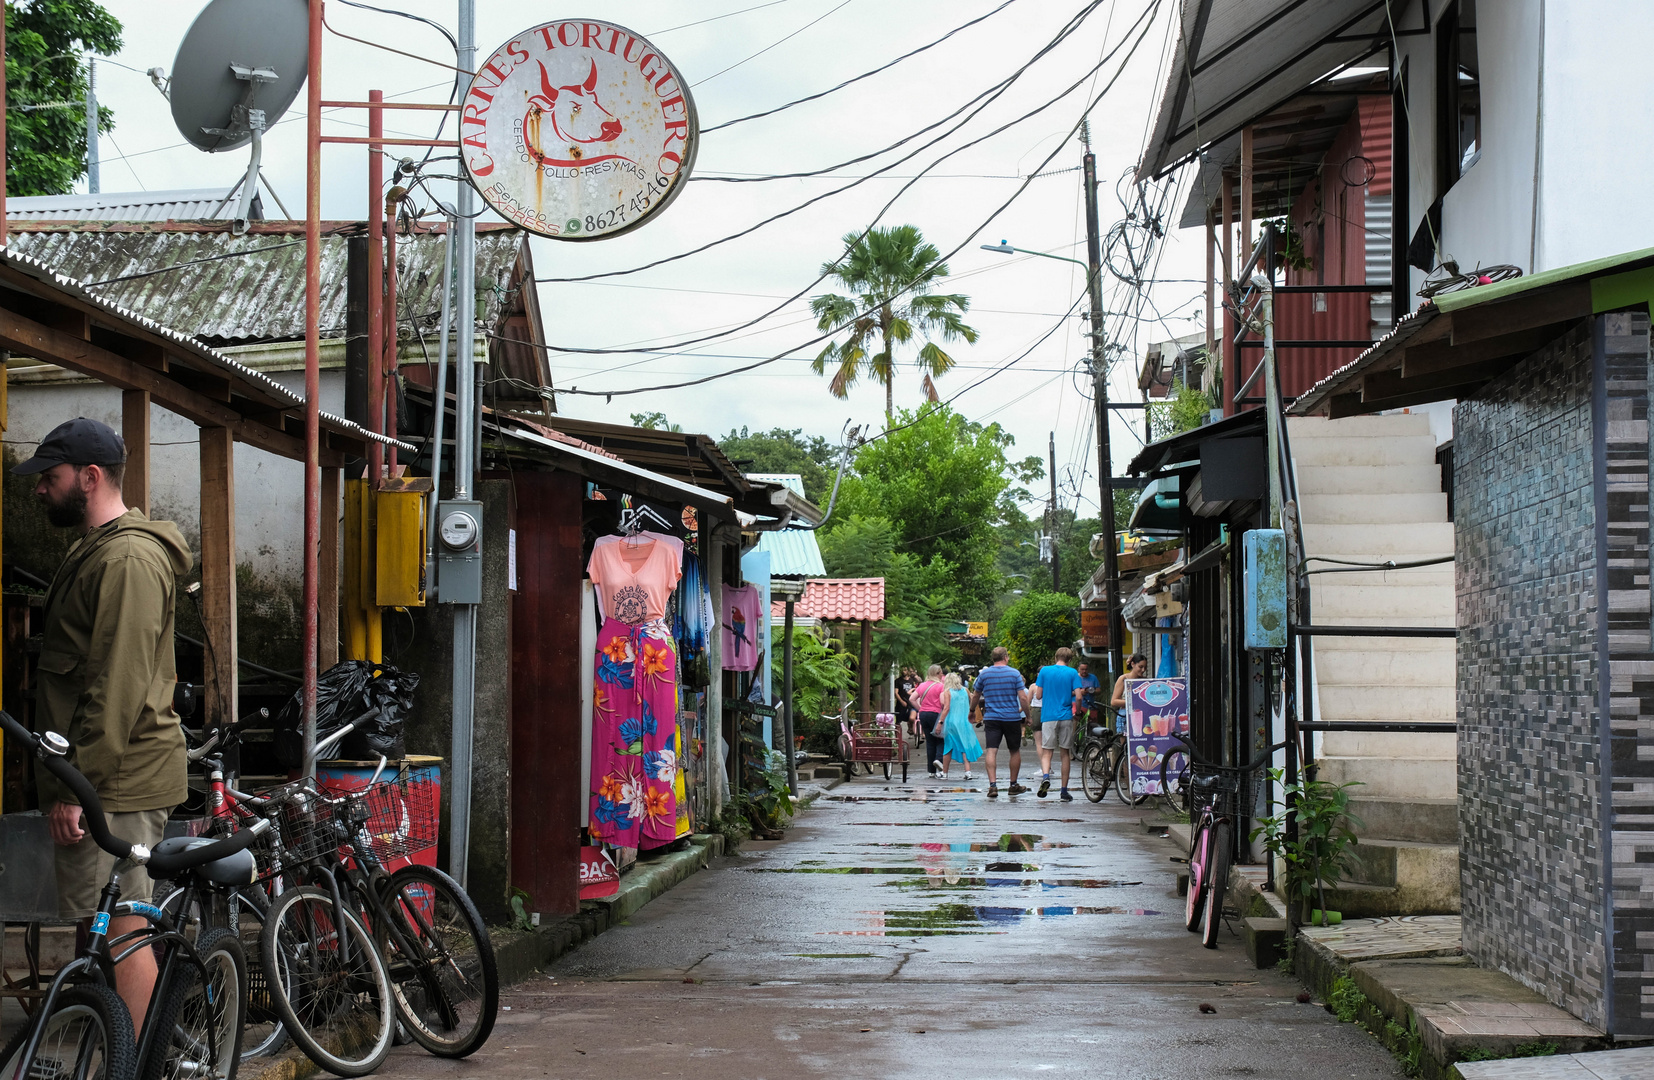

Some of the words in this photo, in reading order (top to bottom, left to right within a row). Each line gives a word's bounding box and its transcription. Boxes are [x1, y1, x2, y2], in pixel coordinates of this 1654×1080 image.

[462, 40, 530, 177] CARNES
[534, 22, 688, 176] TORTUGUERO
[483, 187, 560, 235] EXPRESS
[493, 182, 547, 221] Servicio
[612, 585, 634, 602] Costa
[580, 861, 613, 878] BAC
